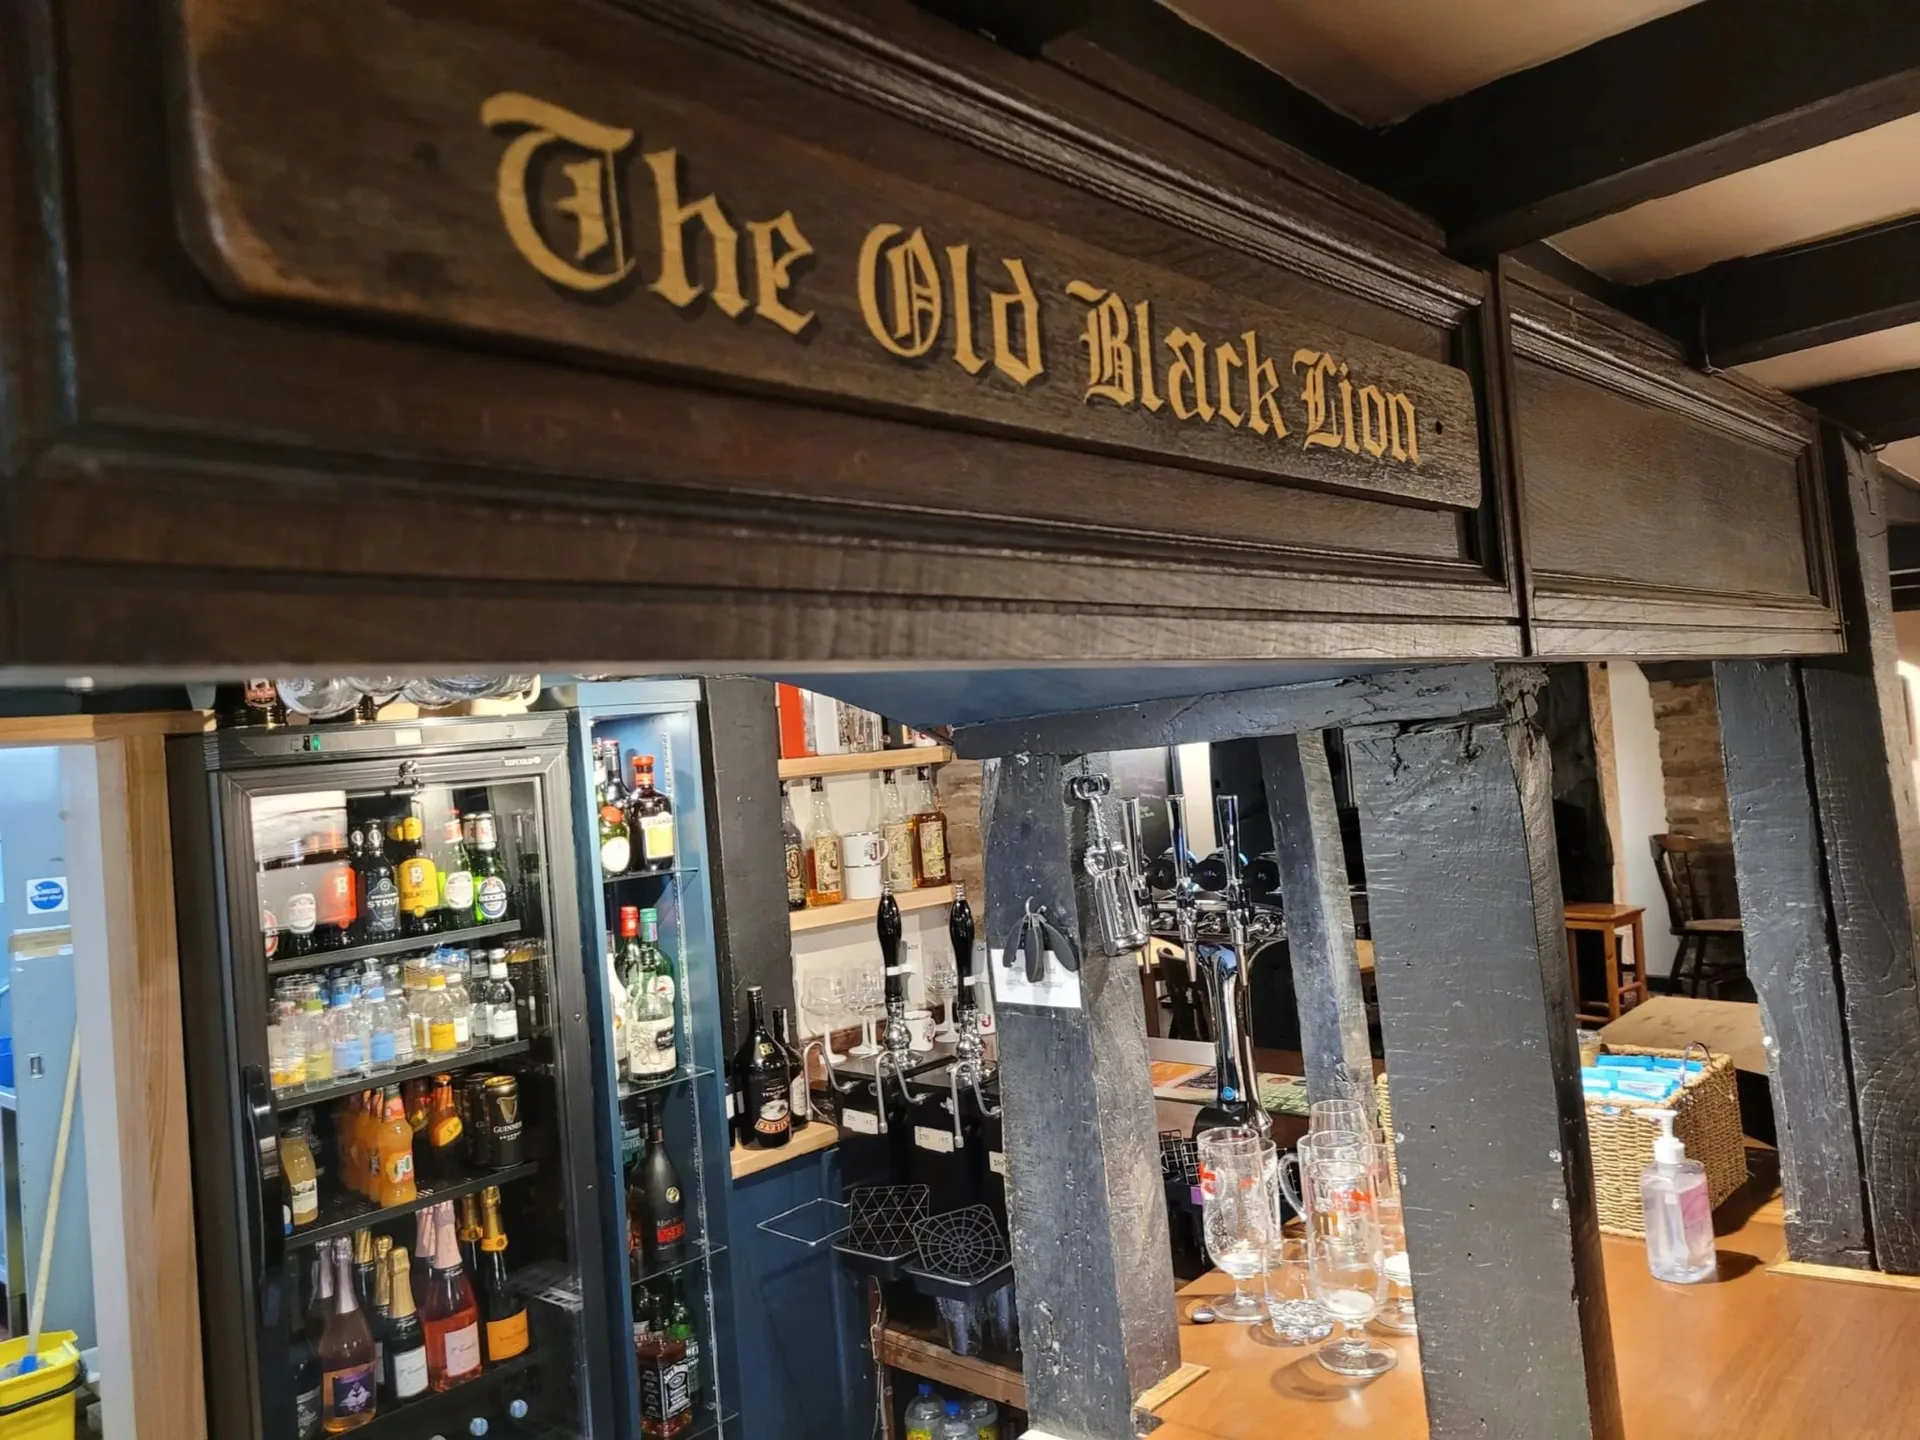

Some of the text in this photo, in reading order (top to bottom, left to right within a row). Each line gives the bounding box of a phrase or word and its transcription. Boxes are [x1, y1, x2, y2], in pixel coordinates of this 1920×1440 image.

[481, 92, 1421, 466] The Old Black Lion
[757, 1116, 790, 1132] AILEYS
